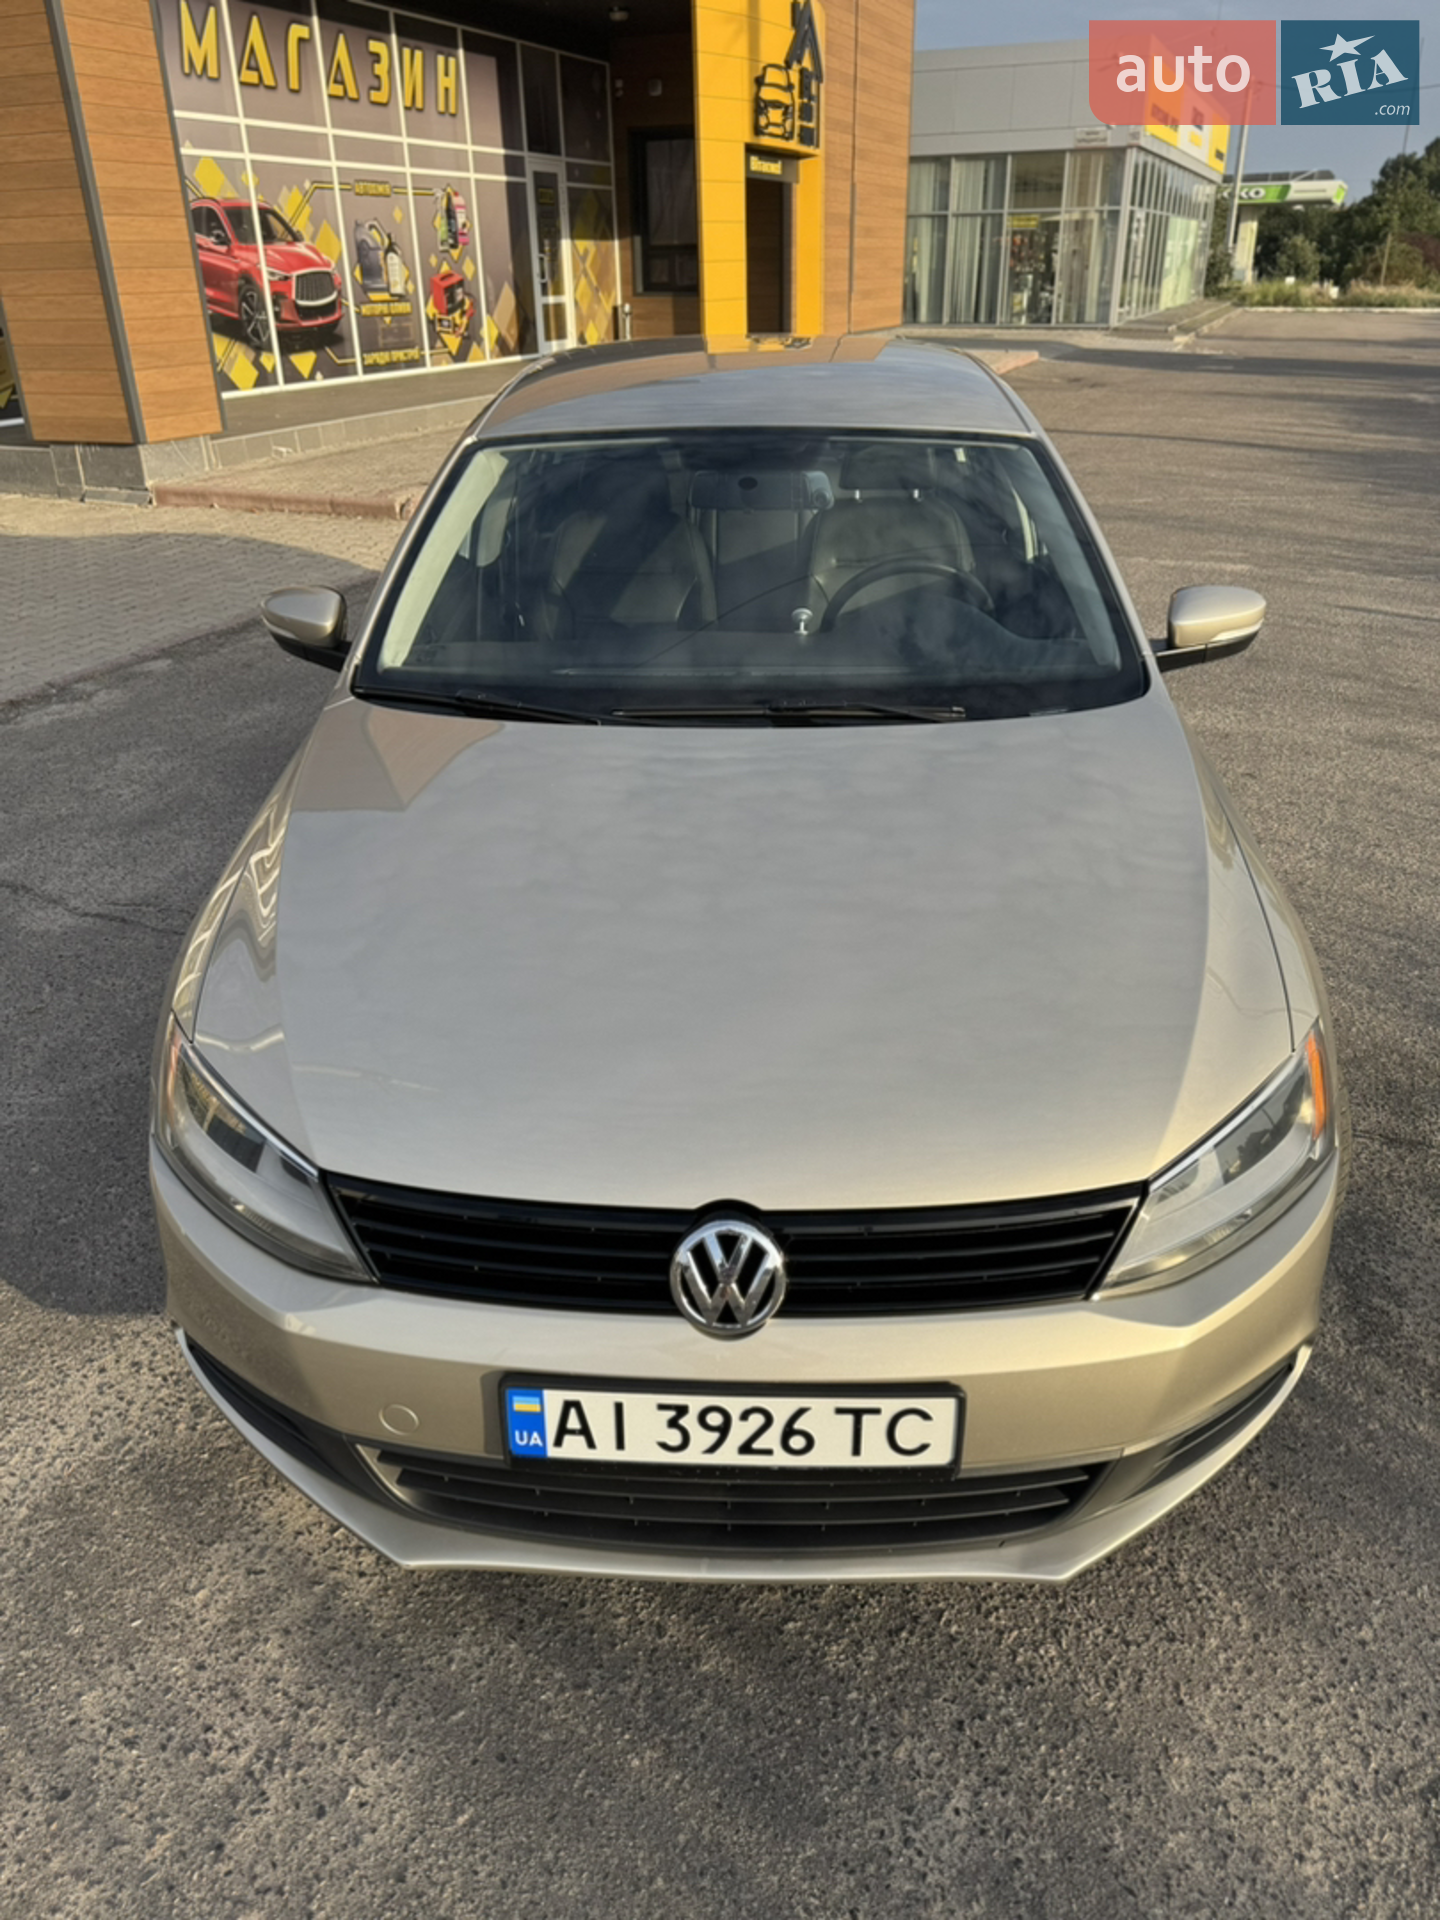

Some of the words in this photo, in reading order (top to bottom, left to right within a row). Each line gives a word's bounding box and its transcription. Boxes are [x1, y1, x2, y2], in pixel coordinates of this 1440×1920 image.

[180, 0, 458, 116] МАГАЗИН
[514, 1430, 543, 1447] UA
[553, 1399, 625, 1451] AI
[656, 1403, 815, 1456] 3926
[834, 1406, 934, 1457] TC
